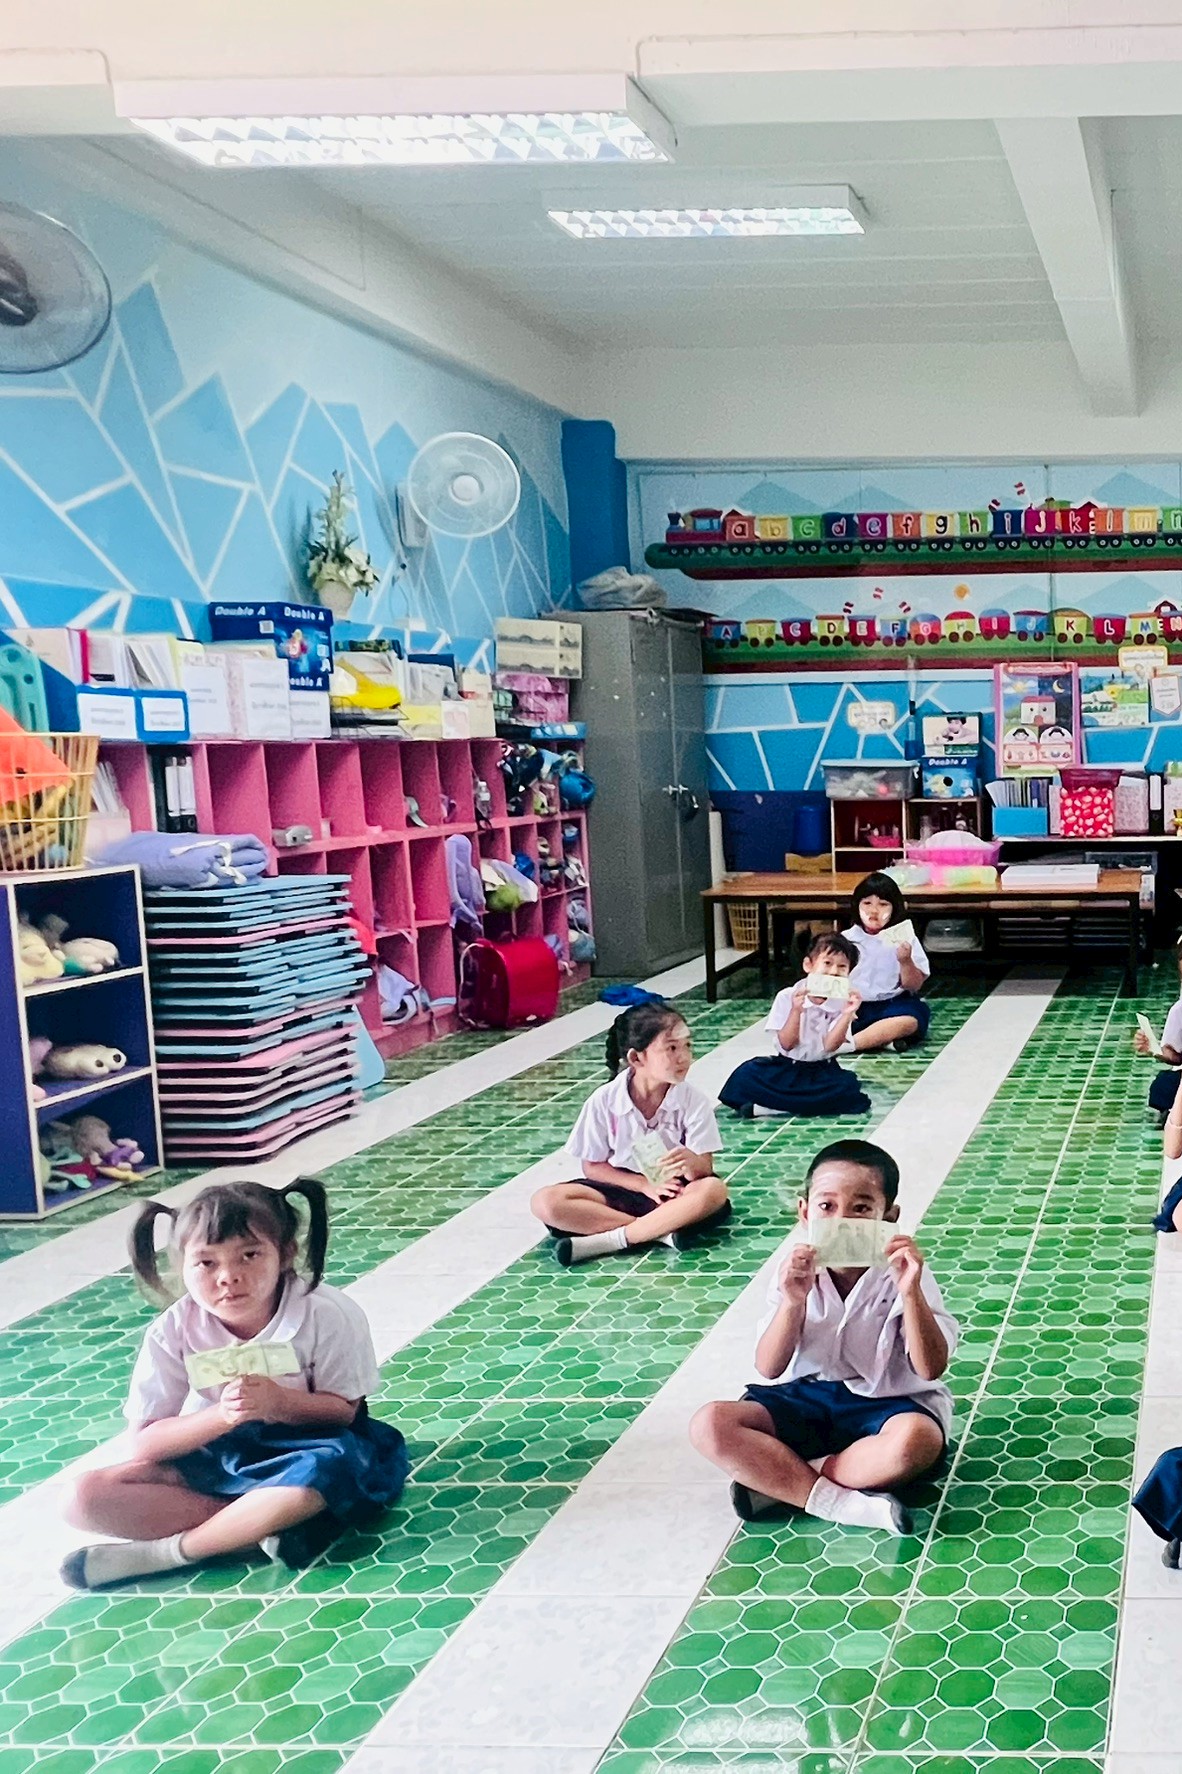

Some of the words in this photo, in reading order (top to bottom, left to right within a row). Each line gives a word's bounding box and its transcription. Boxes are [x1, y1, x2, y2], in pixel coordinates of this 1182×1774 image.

[732, 521, 748, 538] a
[769, 520, 782, 537] b
[832, 517, 846, 536] d
[866, 517, 882, 536] e
[902, 514, 914, 536] f
[935, 515, 948, 535] g
[968, 513, 981, 533] h
[1069, 510, 1082, 533] k
[215, 606, 254, 616] Double
[257, 606, 266, 616] A
[284, 606, 316, 620] Double
[318, 611, 325, 620] A
[720, 627, 733, 640] A
[789, 622, 801, 637] C
[827, 622, 837, 634] D
[857, 621, 867, 636] E
[891, 623, 899, 634] F
[920, 623, 932, 635] G
[1066, 620, 1075, 630] K
[1104, 619, 1115, 635] L
[1140, 621, 1151, 631] M
[1170, 616, 1182, 631] N
[289, 677, 314, 686] ouble
[316, 677, 323, 687] A
[928, 758, 959, 766] Double
[961, 757, 968, 765] A
